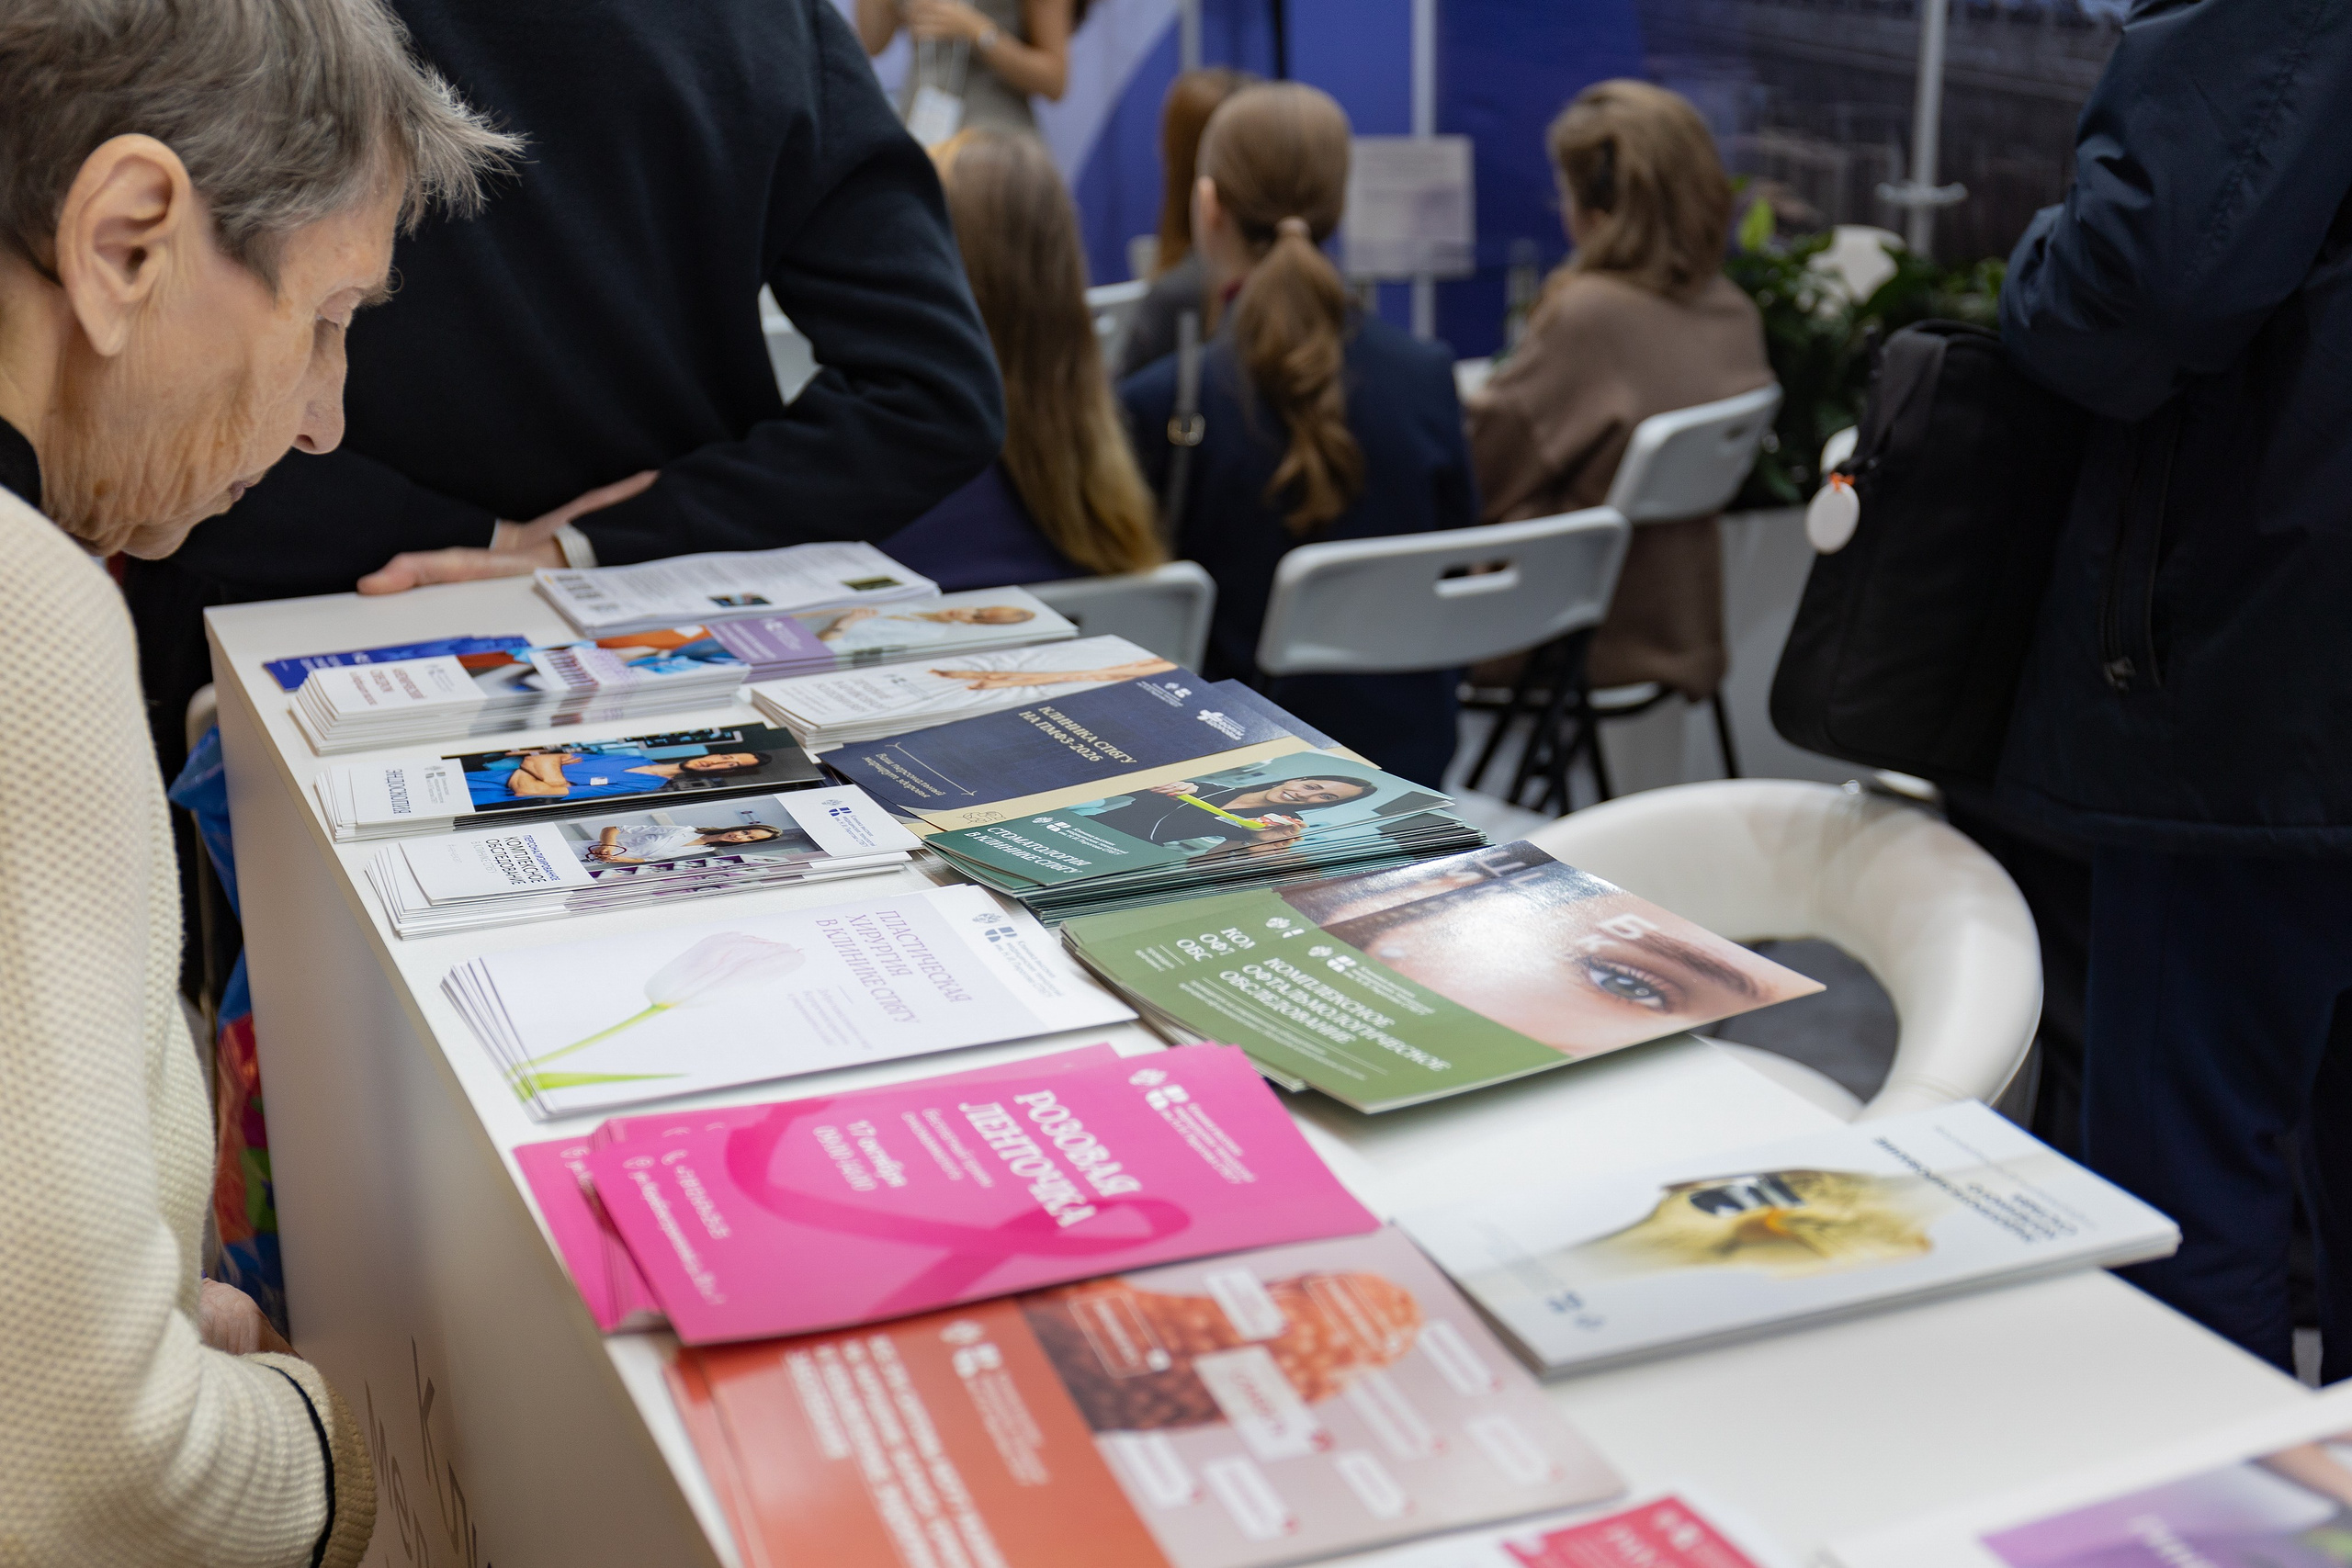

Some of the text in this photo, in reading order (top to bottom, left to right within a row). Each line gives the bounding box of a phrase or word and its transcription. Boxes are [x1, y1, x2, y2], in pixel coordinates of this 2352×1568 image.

[1018, 711, 1103, 761] НА ПМФЗ-2026
[1038, 705, 1137, 763] КЛИНИКА СПбГУ
[386, 768, 412, 814] ЭНДОСКОПИЯ
[486, 839, 526, 886] ОБСЛЕДОВАНИЕ
[504, 836, 547, 884] КОМПЛЕКСНОЕ
[976, 834, 1039, 862] КЛИНИКЕ
[1034, 858, 1083, 874] СПбГУ
[987, 827, 1091, 866] СТОМАТОЛОГИЯ
[816, 919, 836, 928] В
[845, 914, 914, 977] ХИРУРГИЯ
[823, 926, 880, 988] КЛИНИКЕ
[876, 909, 973, 1004] ПЛАСТИЧЕСКАЯ
[871, 985, 919, 1024] СПбГУ
[1219, 970, 1357, 1045] ОБСЛЕДОВАНИЕ
[1242, 964, 1452, 1072] ОФТАЛЬМОЛОГИЧЕСКОЕ
[1263, 957, 1395, 1029] КОМПЛЕКСНОЕ
[957, 1101, 1096, 1228] ЛЕНТОЧКА
[1013, 1089, 1142, 1197] РОЗОВАЯ
